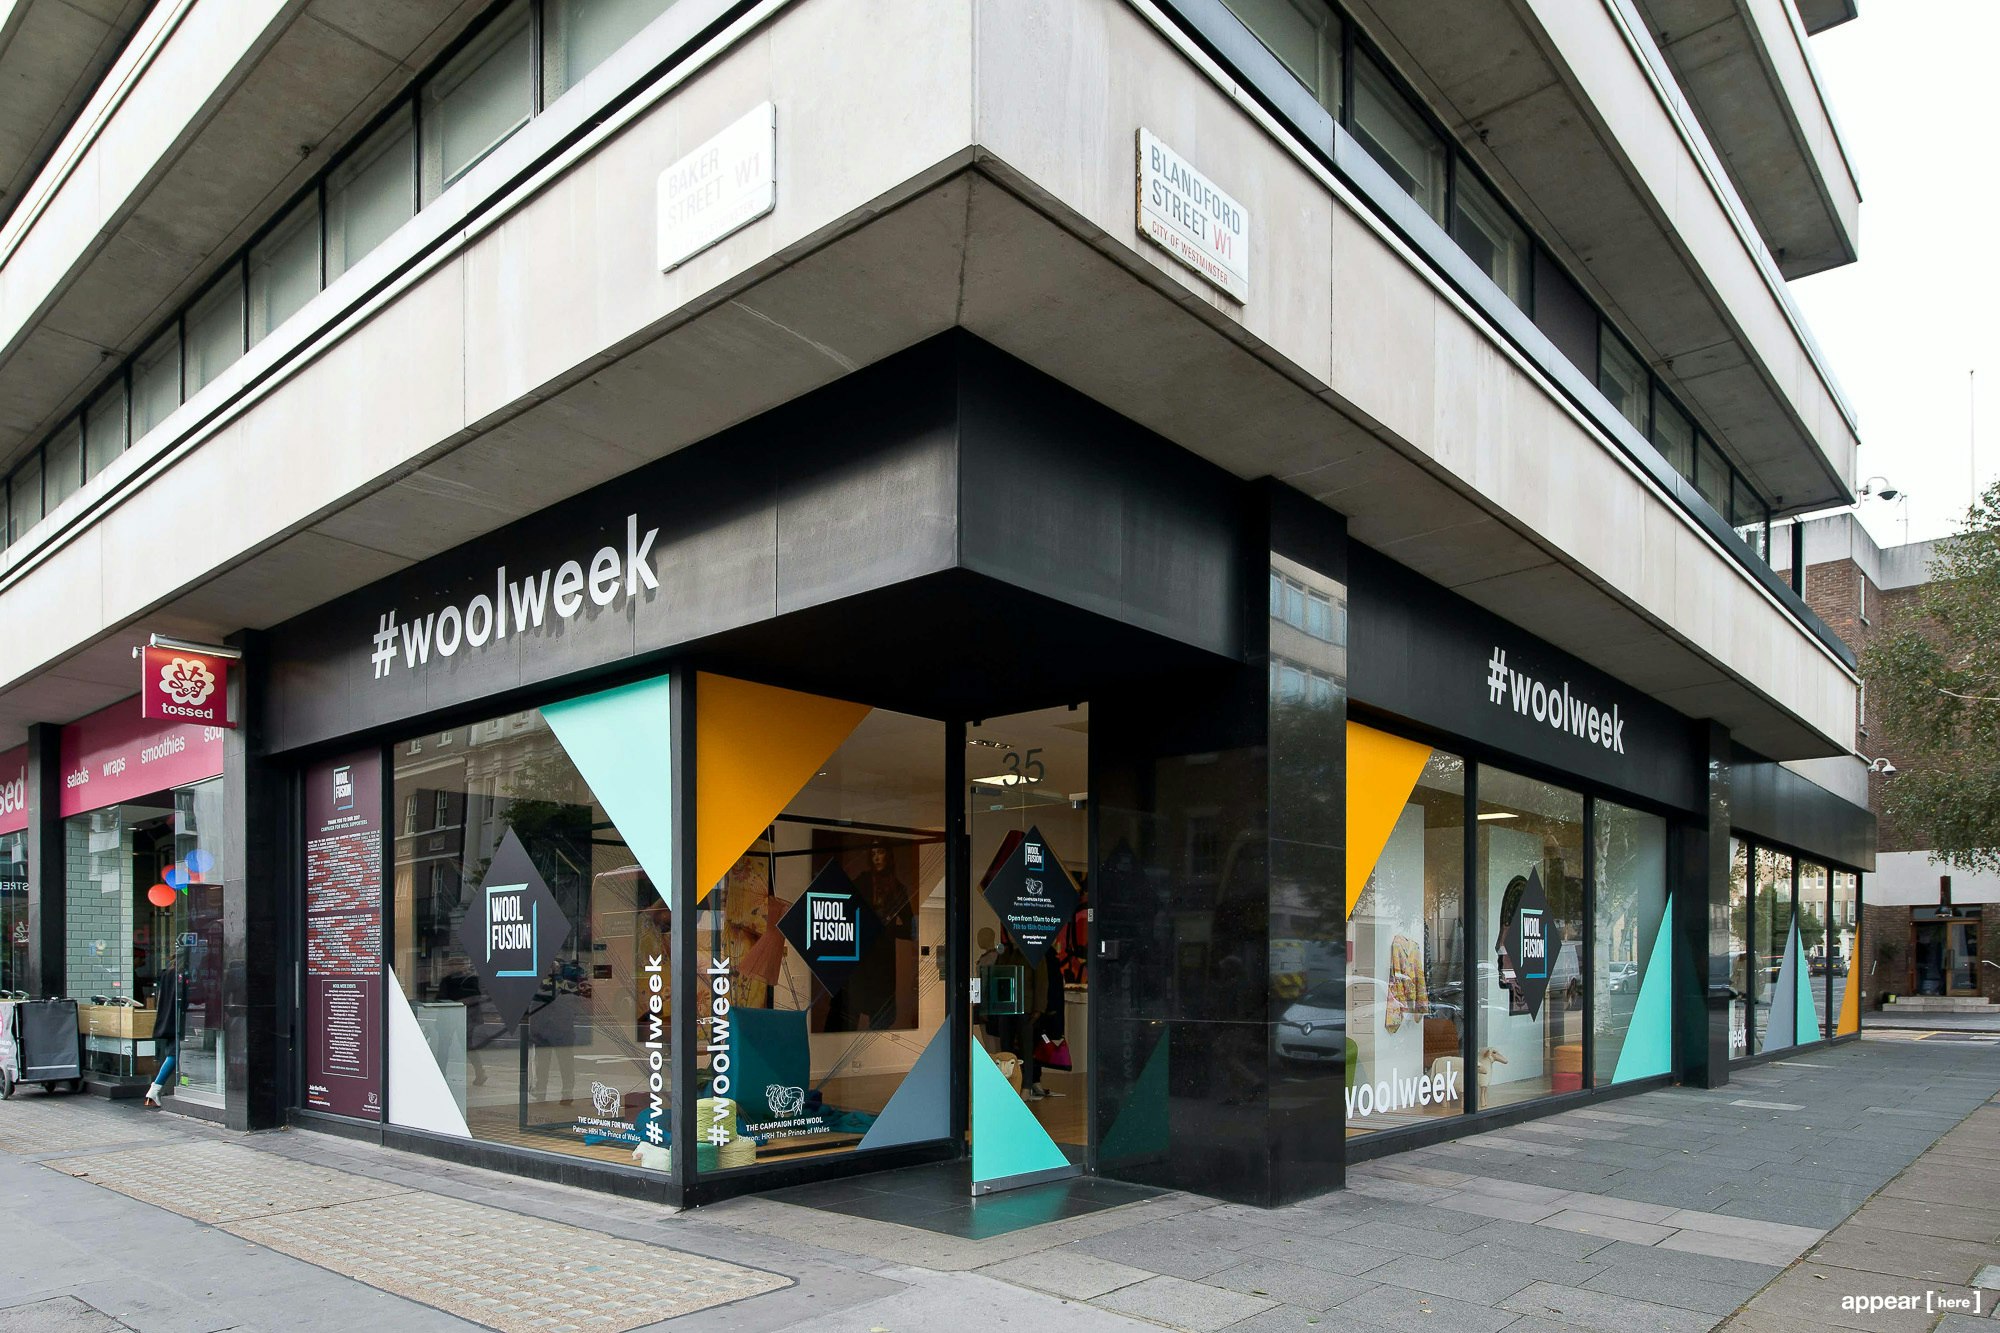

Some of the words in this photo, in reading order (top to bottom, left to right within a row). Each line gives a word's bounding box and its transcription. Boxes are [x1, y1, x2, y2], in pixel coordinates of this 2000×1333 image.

[669, 147, 719, 199] BAKER
[668, 174, 724, 230] STREET
[734, 152, 760, 188] W1
[1151, 144, 1240, 235] BLANDFORD
[1152, 179, 1208, 240] STREET
[1213, 224, 1232, 260] W1
[1152, 220, 1168, 241] CITY
[1170, 234, 1179, 248] OF
[1181, 243, 1228, 285] WESTMINSTER
[371, 513, 660, 679] #woolweek
[161, 702, 213, 719] tossed
[1487, 646, 1625, 755] #woolweek
[66, 767, 89, 789] salads
[102, 756, 126, 778] wraps
[141, 735, 186, 764] smoothies
[1003, 748, 1044, 787] 35
[335, 771, 348, 786] WOOL
[335, 783, 351, 799] FUSION
[1027, 846, 1039, 855] WOOL
[1027, 854, 1042, 864] FUSION
[491, 895, 523, 922] WOOL
[812, 900, 847, 921] WOOL
[1007, 915, 1020, 923] Open
[491, 923, 531, 950] FUSION
[813, 921, 854, 941] FUSION
[1524, 917, 1541, 937] WOOL
[1524, 938, 1545, 958] FUSION
[645, 954, 663, 1145] #woolweek
[706, 956, 730, 1147] #woolweek
[572, 1125, 588, 1133] Patron:
[588, 1127, 598, 1135] HRH
[598, 1128, 607, 1137] The
[607, 1130, 621, 1139] Prince
[626, 1133, 641, 1142] Wales
[578, 1116, 587, 1124] THE
[587, 1117, 611, 1127] CAMPAIGN
[611, 1120, 621, 1129] FOR
[621, 1122, 635, 1131] WOOL
[746, 1123, 759, 1132] THE
[759, 1119, 792, 1130] CAMPAIGN
[793, 1118, 805, 1126] FOR
[806, 1116, 824, 1125] WOOL
[761, 1132, 775, 1140] HRH
[787, 1129, 806, 1137] Prince
[807, 1127, 813, 1135] of
[813, 1126, 830, 1134] Wales
